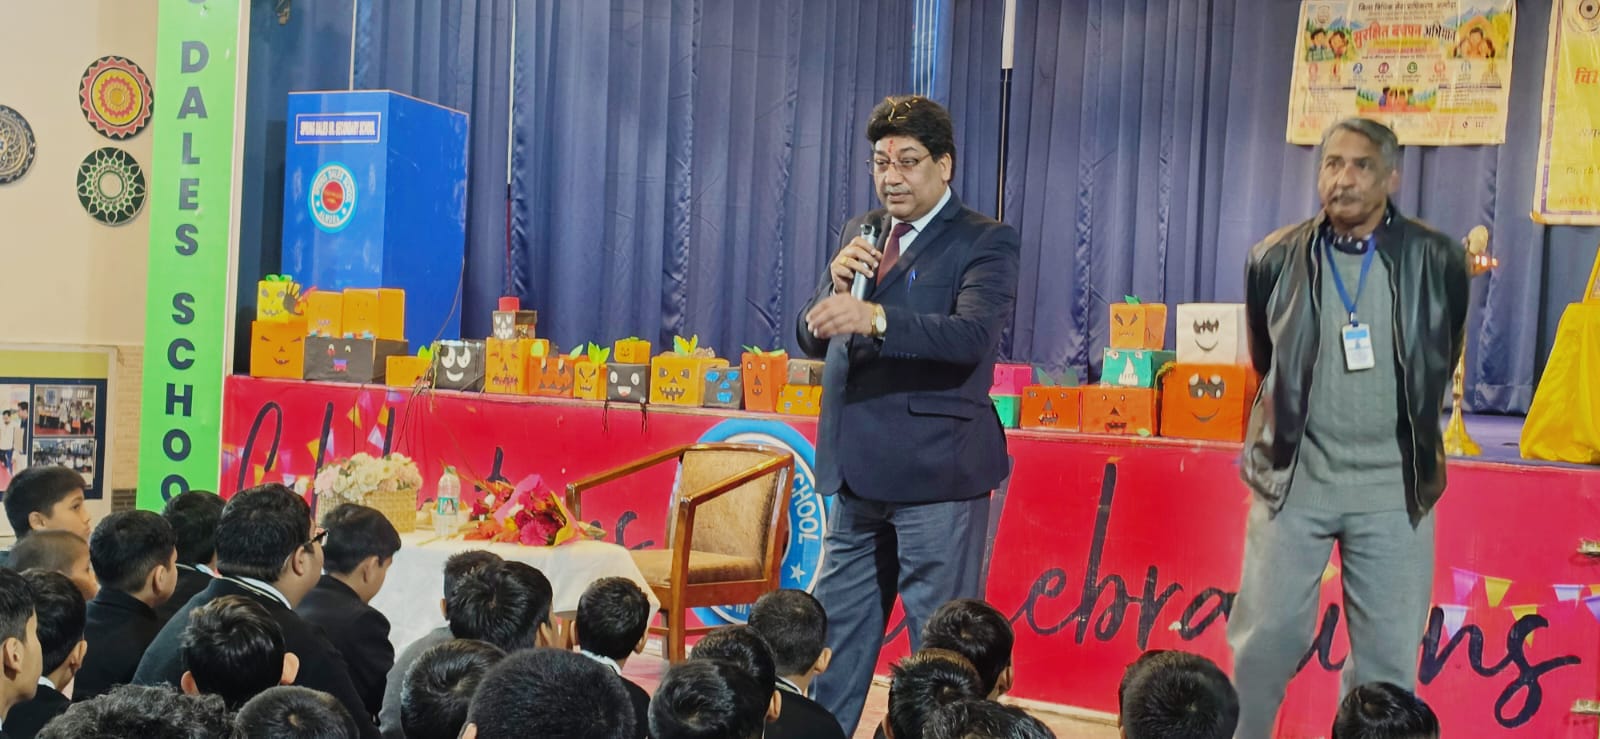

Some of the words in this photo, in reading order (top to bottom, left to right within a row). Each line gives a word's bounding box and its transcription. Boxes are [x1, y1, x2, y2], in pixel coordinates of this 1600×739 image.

[1353, 20, 1389, 48] सुरक्षित
[175, 40, 210, 257] DALES
[160, 291, 196, 502] SCHOO
[791, 474, 820, 545] CHOOL
